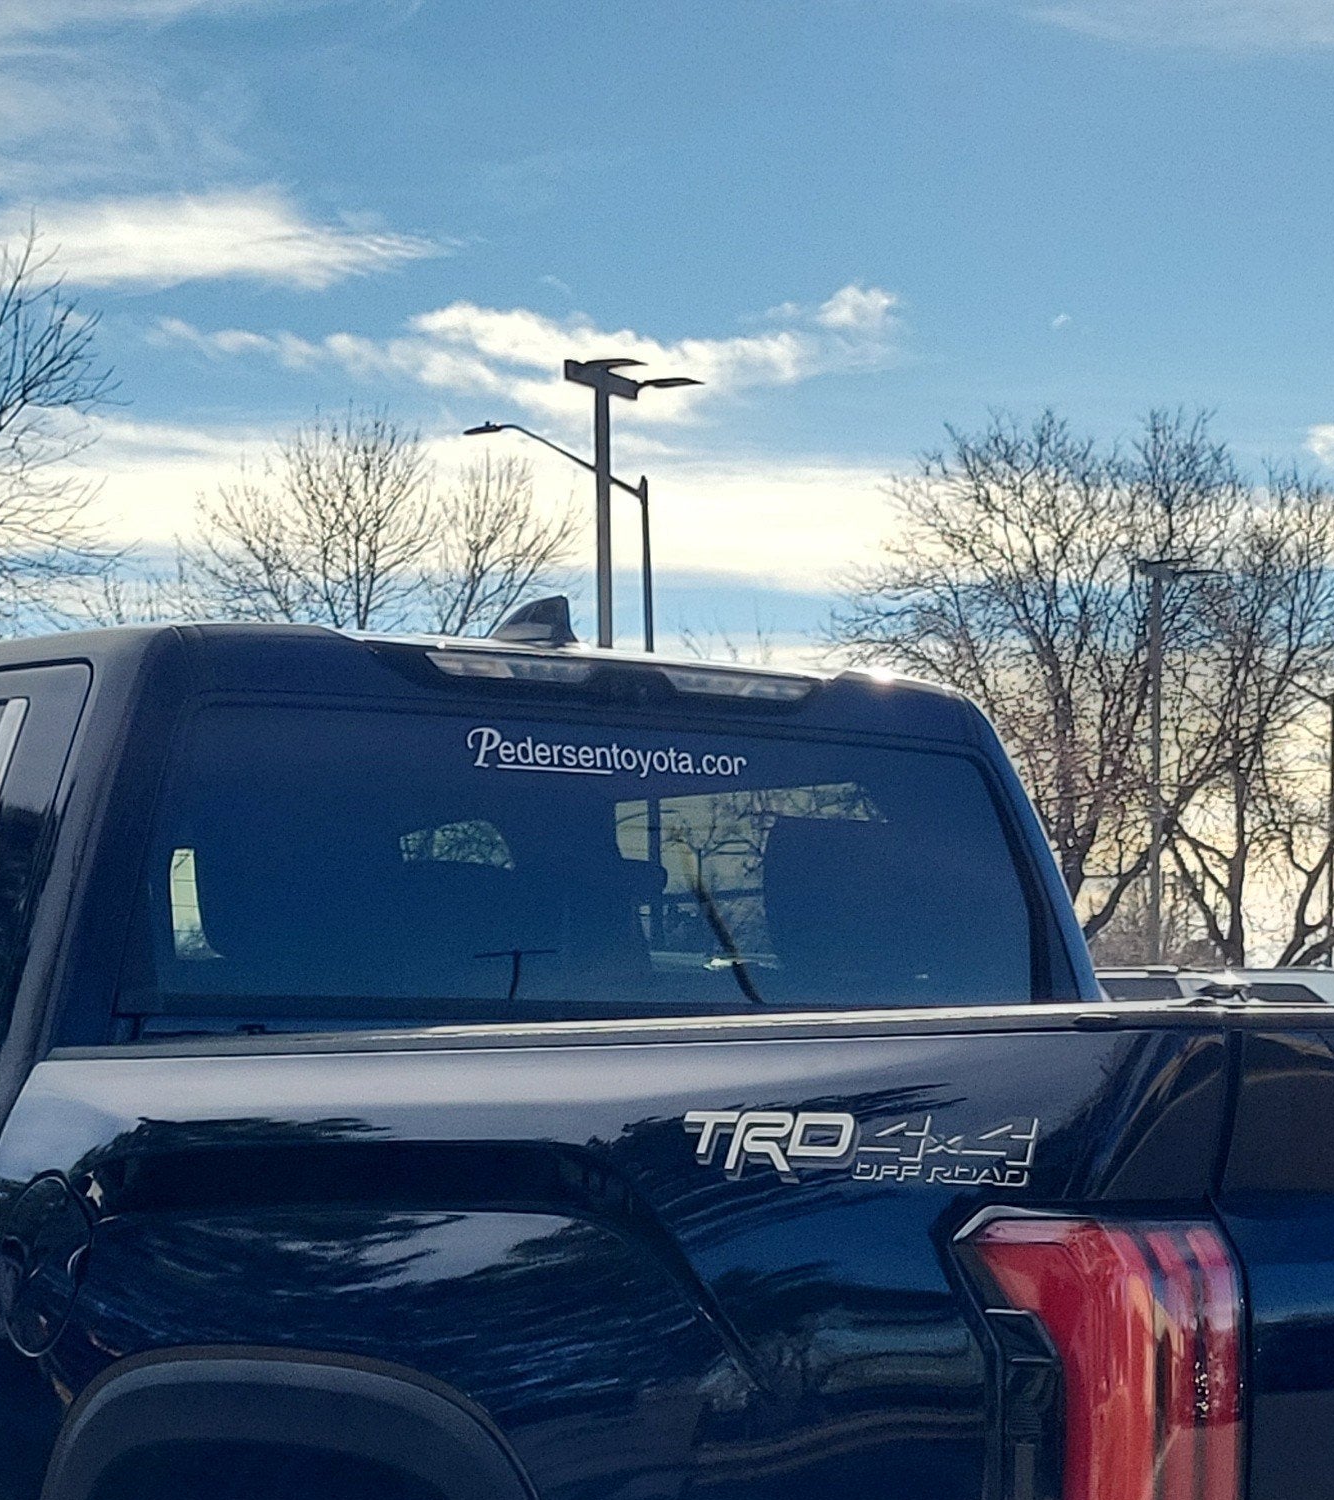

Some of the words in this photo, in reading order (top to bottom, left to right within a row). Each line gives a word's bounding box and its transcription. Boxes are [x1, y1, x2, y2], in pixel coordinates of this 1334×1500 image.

[684, 1111, 861, 1184] TRD
[852, 1161, 922, 1183] OFF
[925, 1164, 1031, 1188] ROAD
